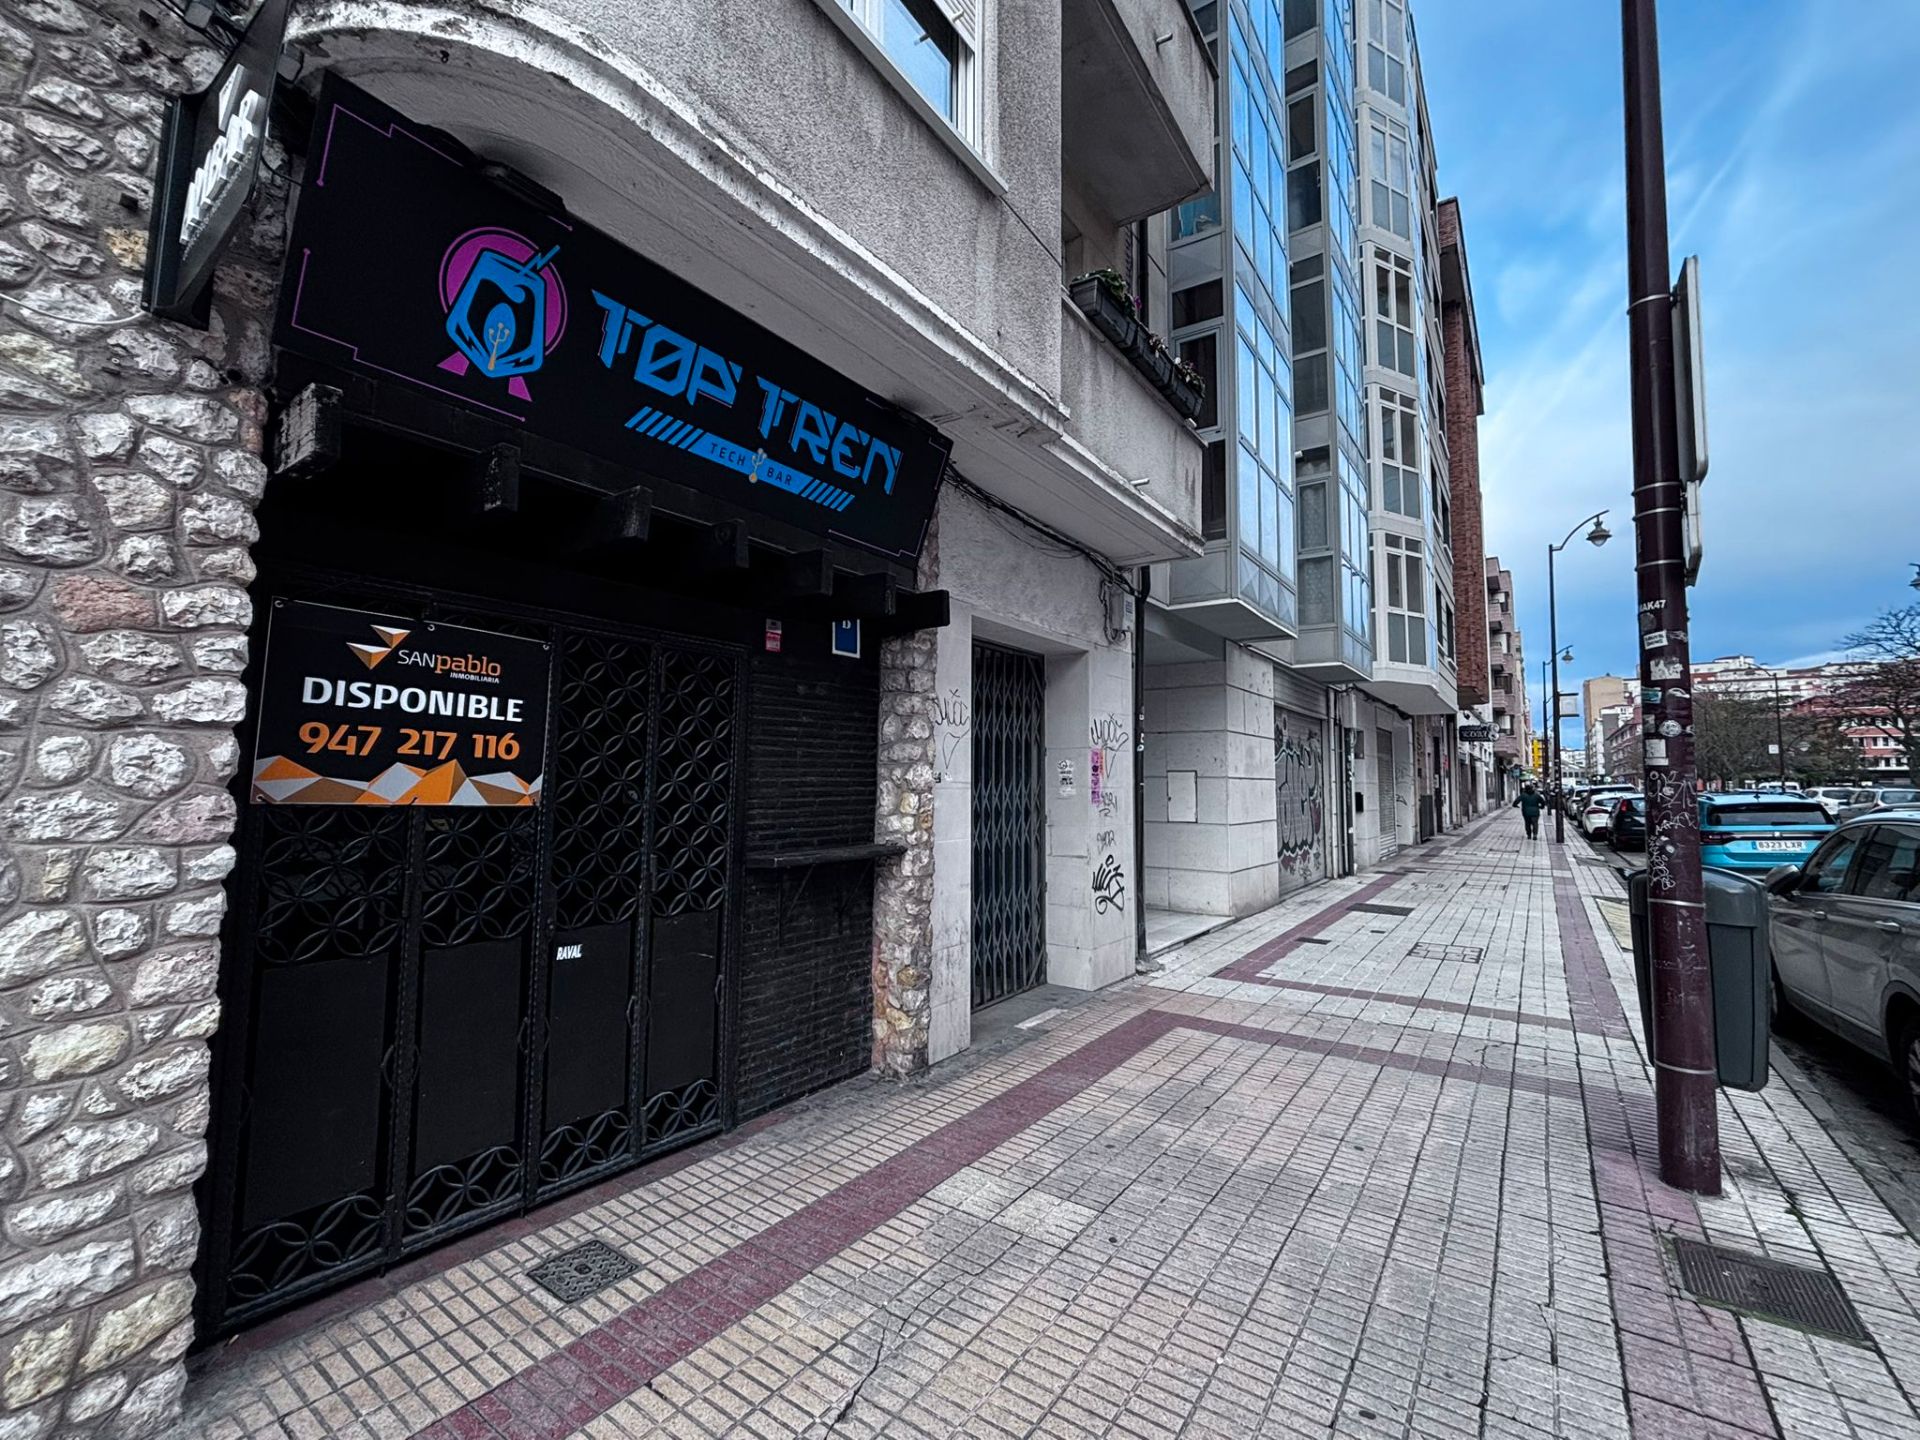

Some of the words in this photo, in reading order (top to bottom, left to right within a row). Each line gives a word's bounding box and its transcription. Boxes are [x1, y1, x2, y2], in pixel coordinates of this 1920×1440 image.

[756, 375, 903, 496] TREN
[709, 442, 747, 467] TECH
[766, 467, 793, 486] BAR
[449, 672, 501, 684] INMOBILIARIA
[302, 676, 524, 723] DISPONIBLE
[298, 721, 382, 757] 947
[396, 728, 458, 761] 217
[471, 732, 521, 761] 116
[556, 944, 583, 960] RAVAL
